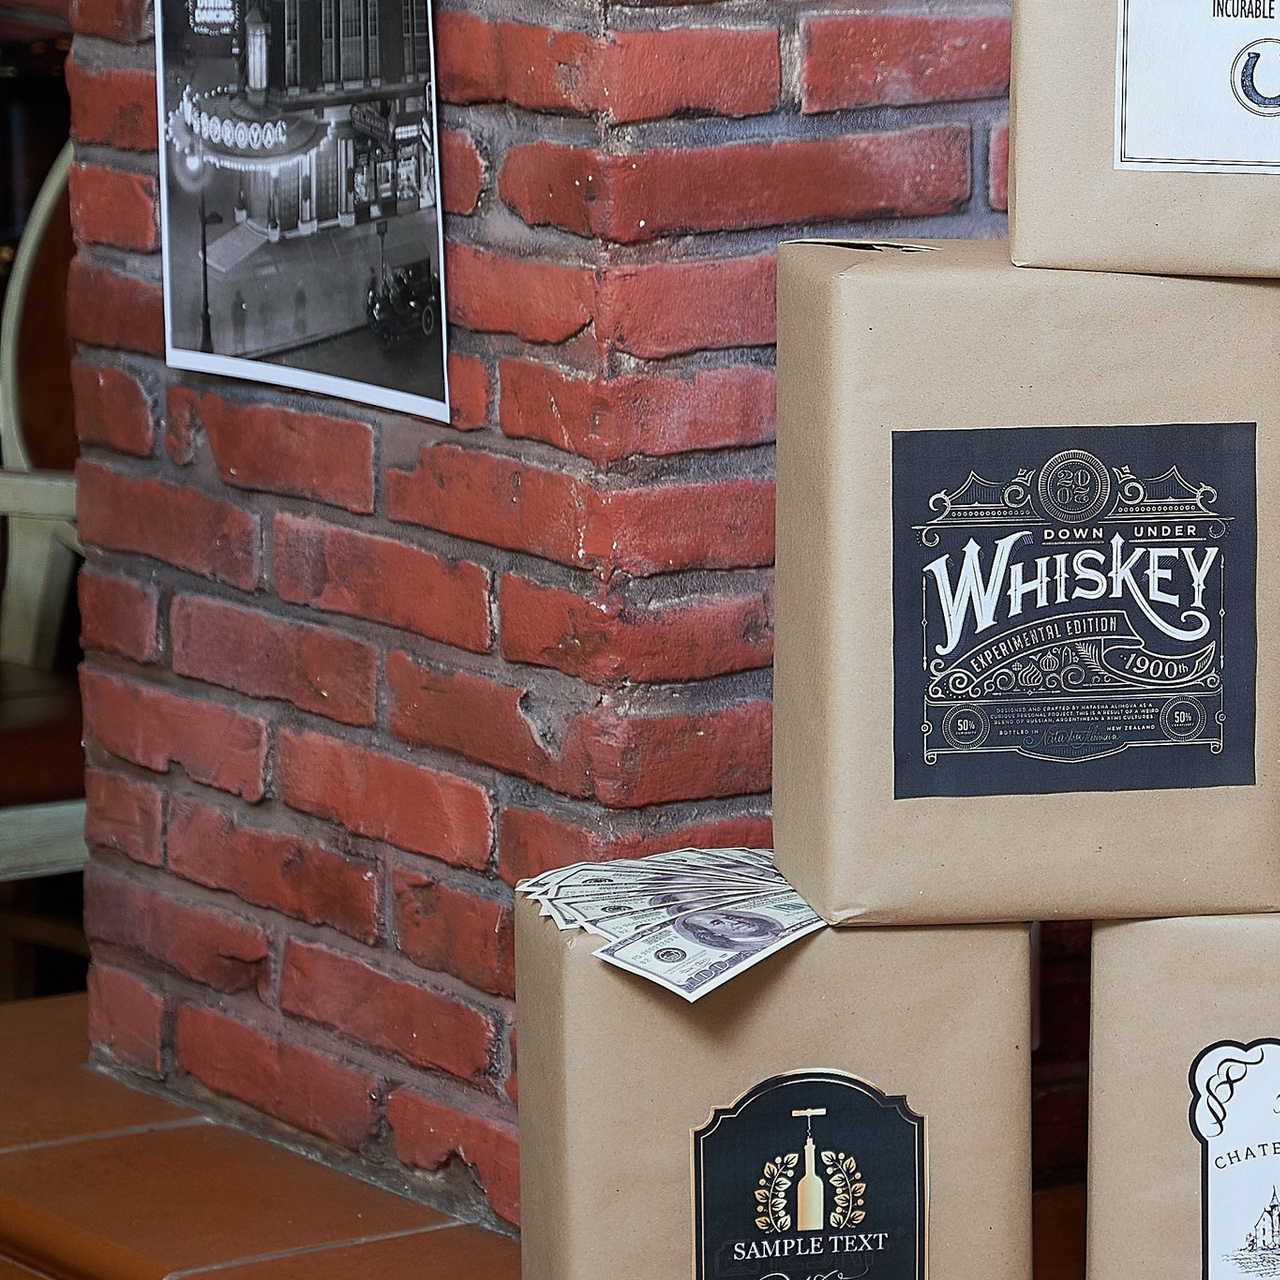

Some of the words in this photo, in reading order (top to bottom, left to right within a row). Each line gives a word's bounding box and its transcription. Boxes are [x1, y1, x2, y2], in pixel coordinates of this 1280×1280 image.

[1044, 528, 1103, 540] DOWN
[1135, 525, 1196, 537] UNDER
[922, 530, 1220, 655] WHISKEY
[970, 622, 1062, 673] EXPERIMENTAL
[1066, 616, 1117, 634] EDITION
[957, 719, 975, 731] 50%
[1174, 711, 1191, 723] 50%
[733, 1237, 823, 1261] SAMPLE
[829, 1233, 889, 1253] TEXT
